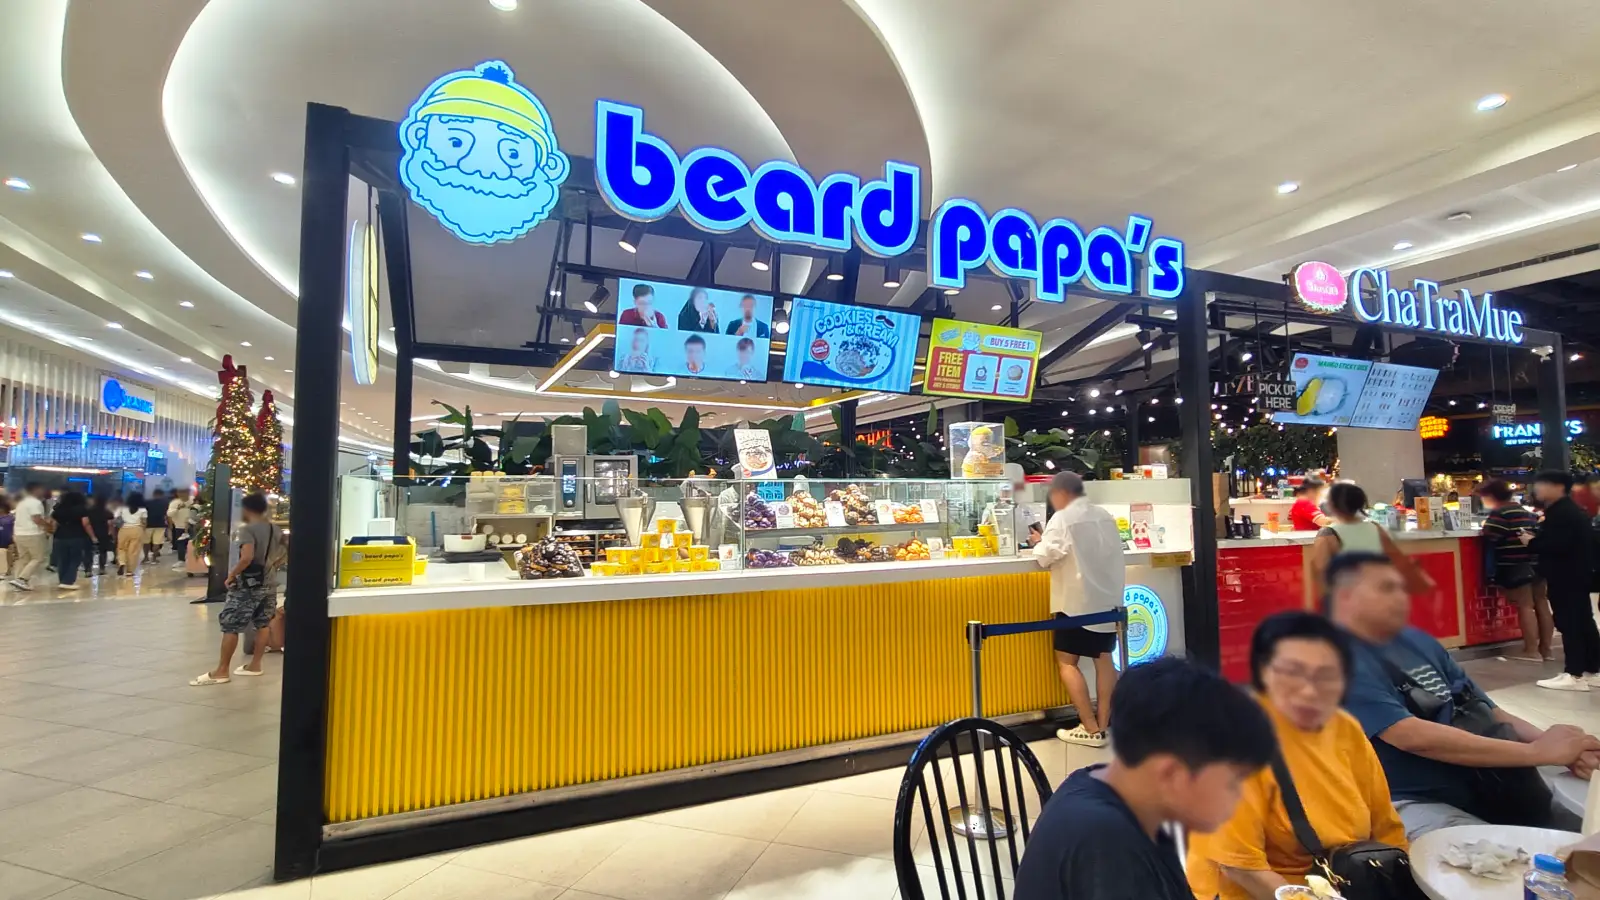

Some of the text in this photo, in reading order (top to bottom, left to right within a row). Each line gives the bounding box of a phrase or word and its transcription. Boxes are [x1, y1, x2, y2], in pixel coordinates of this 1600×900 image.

[598, 102, 1182, 300] beard papa's
[1352, 267, 1524, 344] ChaTraMue
[815, 310, 877, 334] COOKIES
[990, 337, 1004, 347] BUY
[1004, 339, 1010, 348] 5
[1010, 339, 1026, 350] FREE
[939, 351, 964, 366] FREE
[936, 364, 961, 378] ITEM
[1259, 383, 1281, 395] PICK
[1283, 384, 1296, 395] UP
[1265, 396, 1292, 408] HERE
[1133, 592, 1159, 615] papa's
